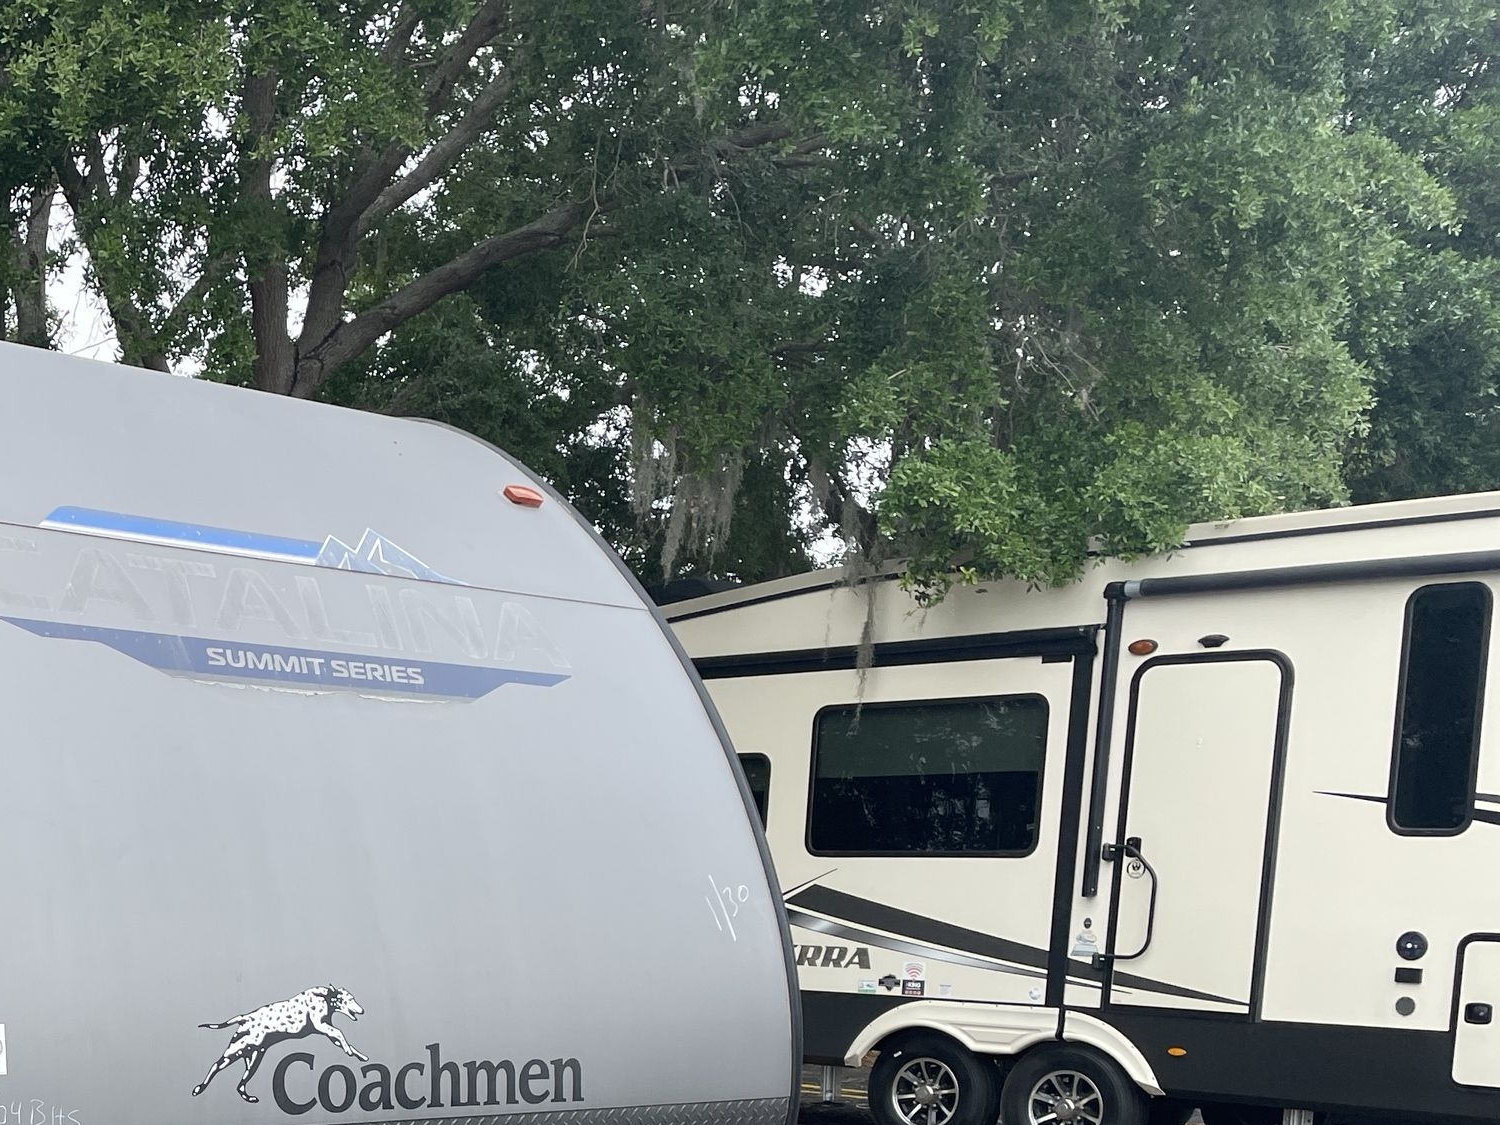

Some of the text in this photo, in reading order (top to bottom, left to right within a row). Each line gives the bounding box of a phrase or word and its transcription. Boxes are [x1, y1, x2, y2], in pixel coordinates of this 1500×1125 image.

[206, 647, 425, 685] SUMMIT SERIES
[794, 944, 871, 970] RRA
[272, 1043, 585, 1116] Coachmen
